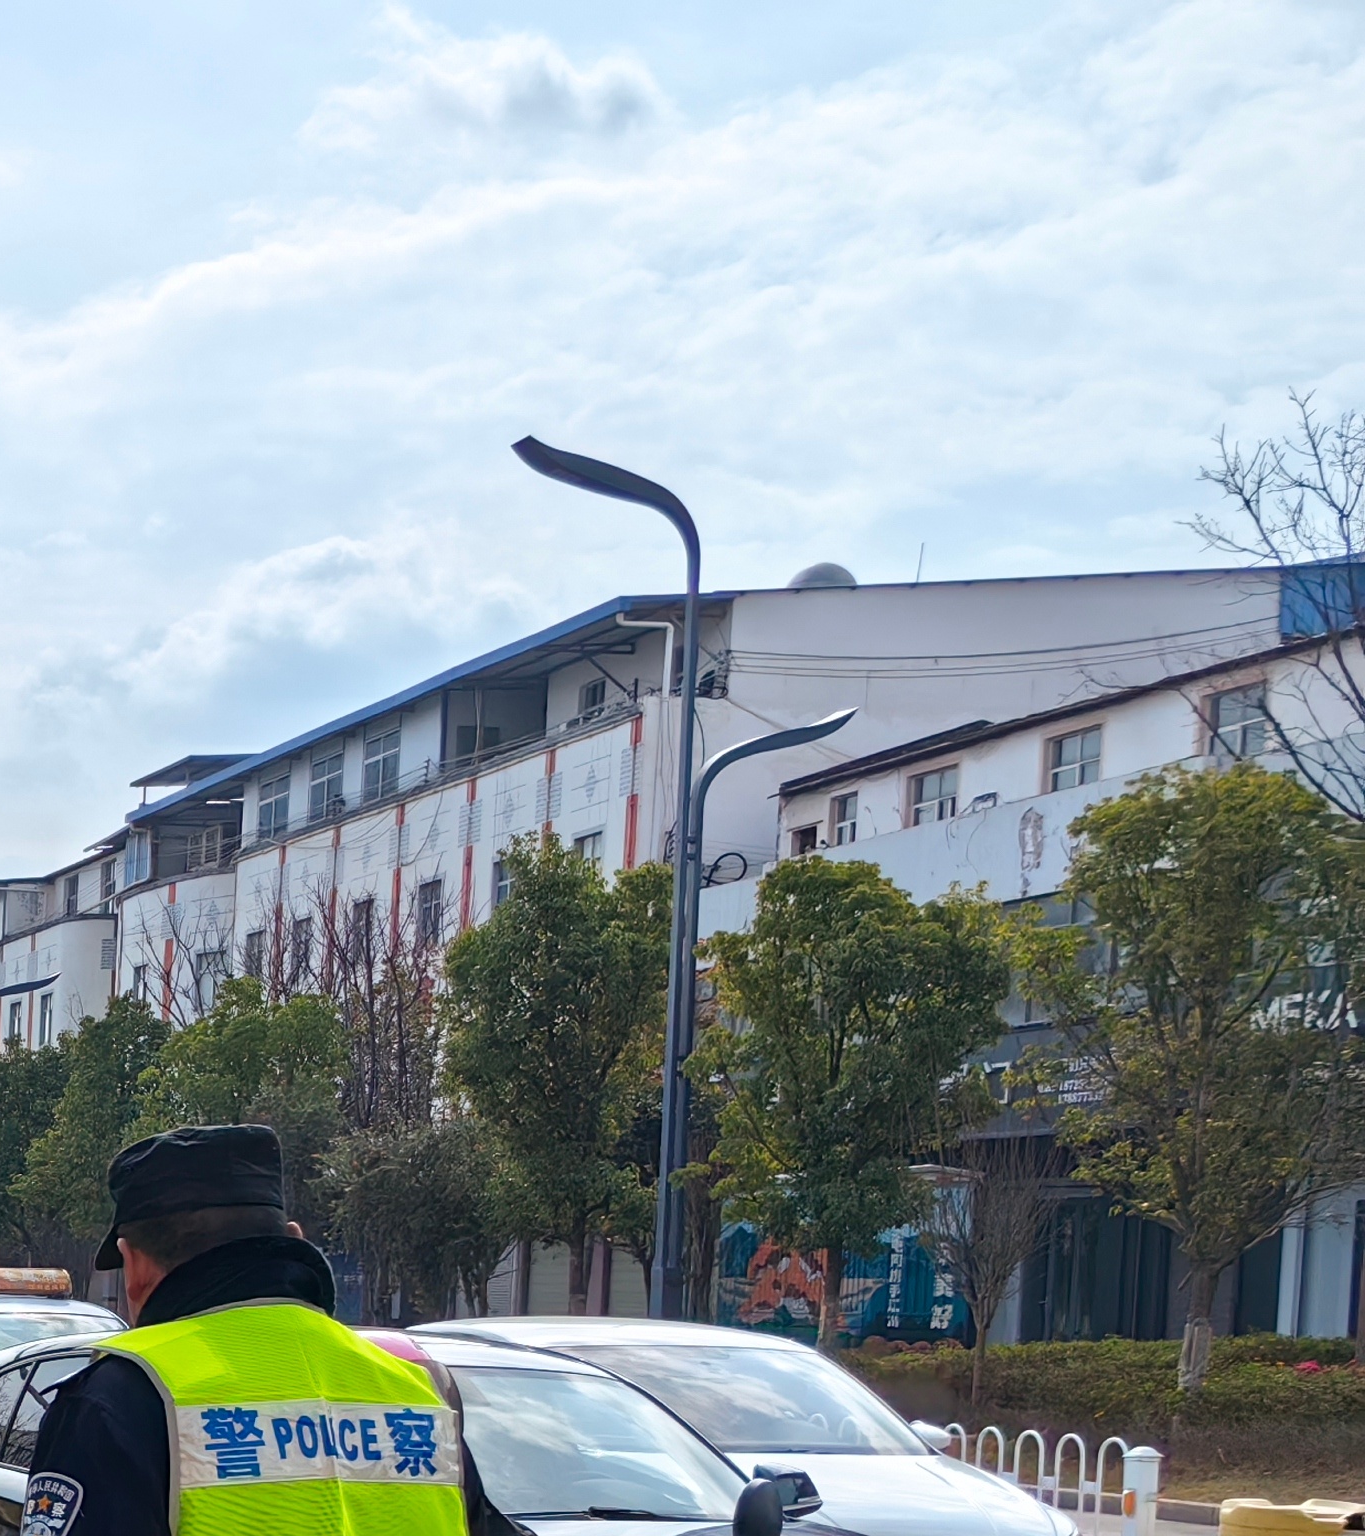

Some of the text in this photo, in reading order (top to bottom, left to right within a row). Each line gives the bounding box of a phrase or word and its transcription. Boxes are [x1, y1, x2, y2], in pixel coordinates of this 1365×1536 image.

[201, 1407, 437, 1478] 警 POLICE 察
